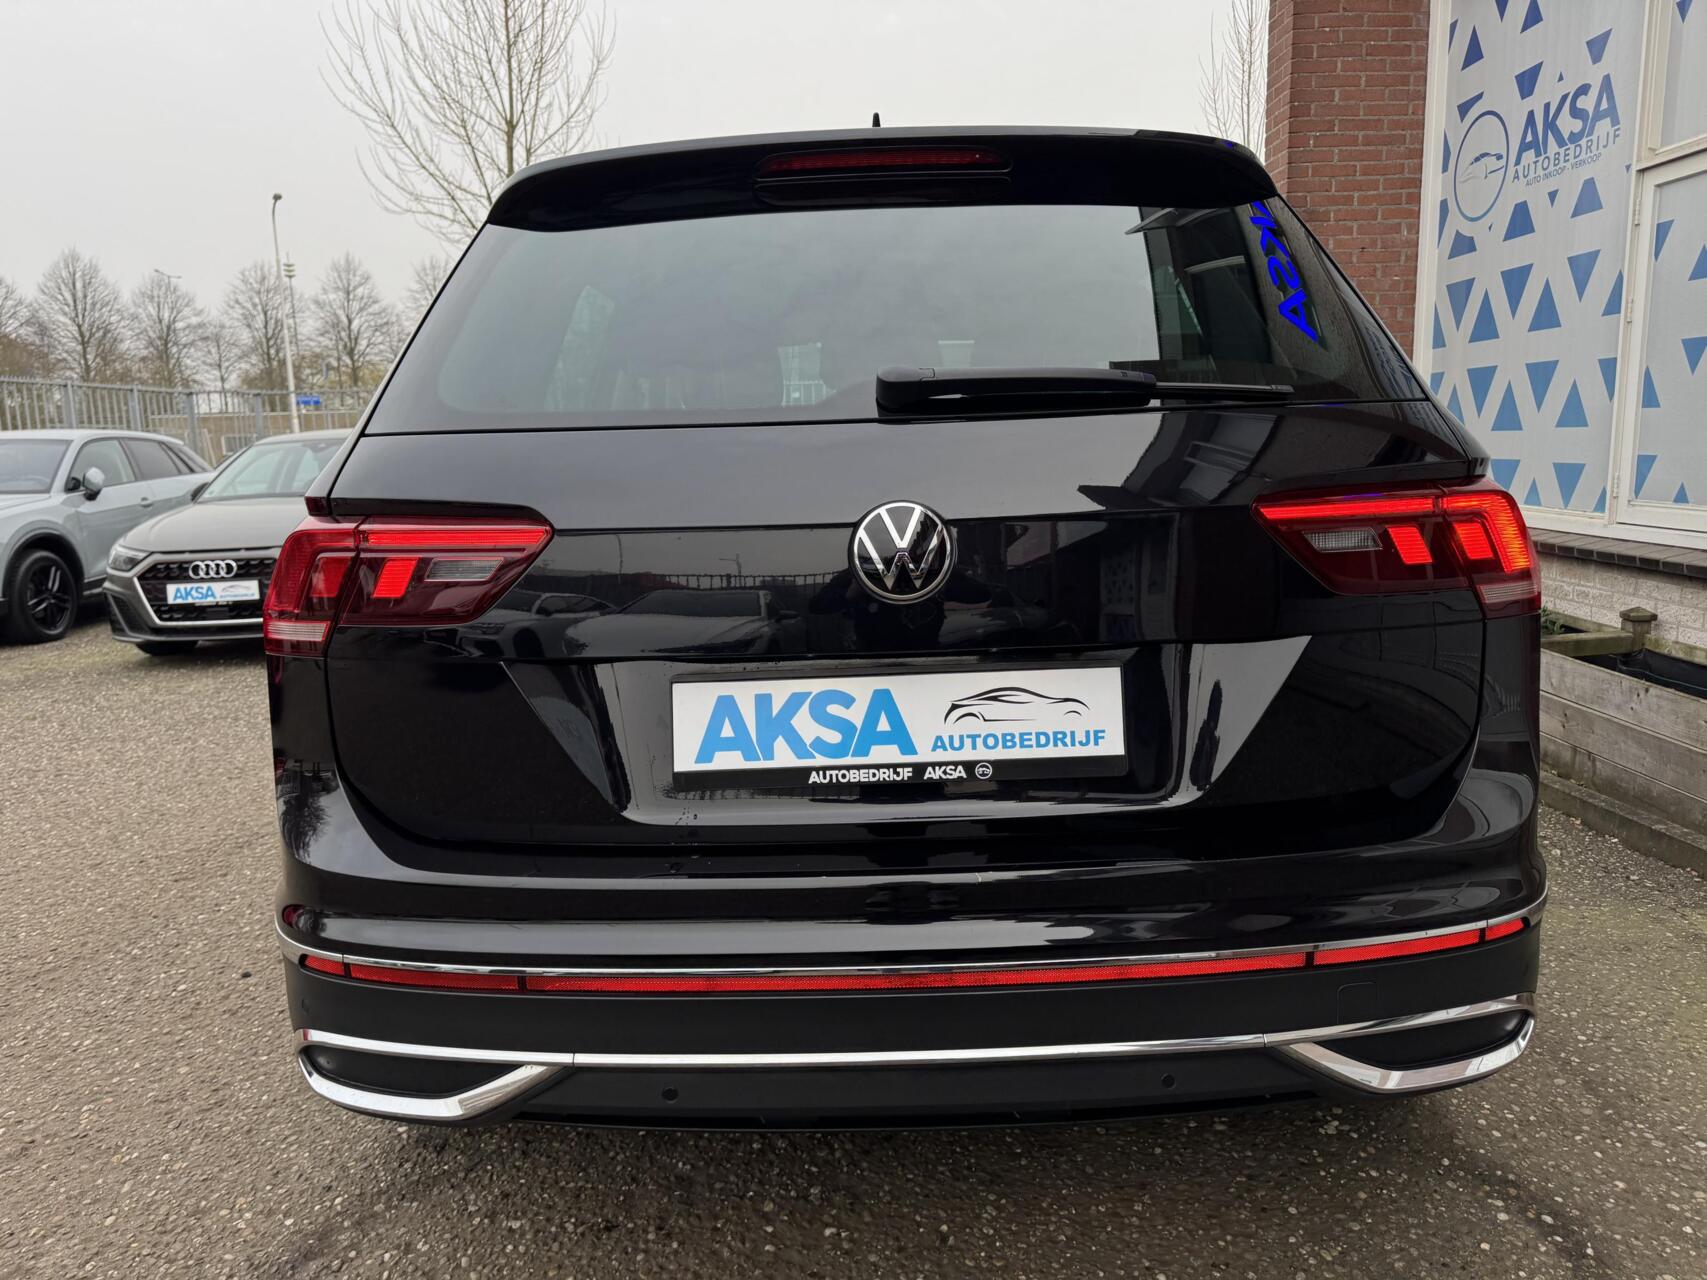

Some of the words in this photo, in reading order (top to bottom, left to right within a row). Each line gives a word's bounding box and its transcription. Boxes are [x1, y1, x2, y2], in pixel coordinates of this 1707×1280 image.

[1513, 73, 1620, 167] AKSA
[1511, 127, 1621, 183] AUTOBEDRIJF
[1525, 174, 1542, 187] AUTO
[1570, 152, 1602, 170] VERKOOP
[173, 586, 217, 601] AKSA
[694, 688, 918, 764] AKSA
[930, 729, 1106, 752] AUTOBEDRIJF
[808, 767, 913, 784] AUTOBEDRIJF
[923, 765, 967, 780] AKSA
